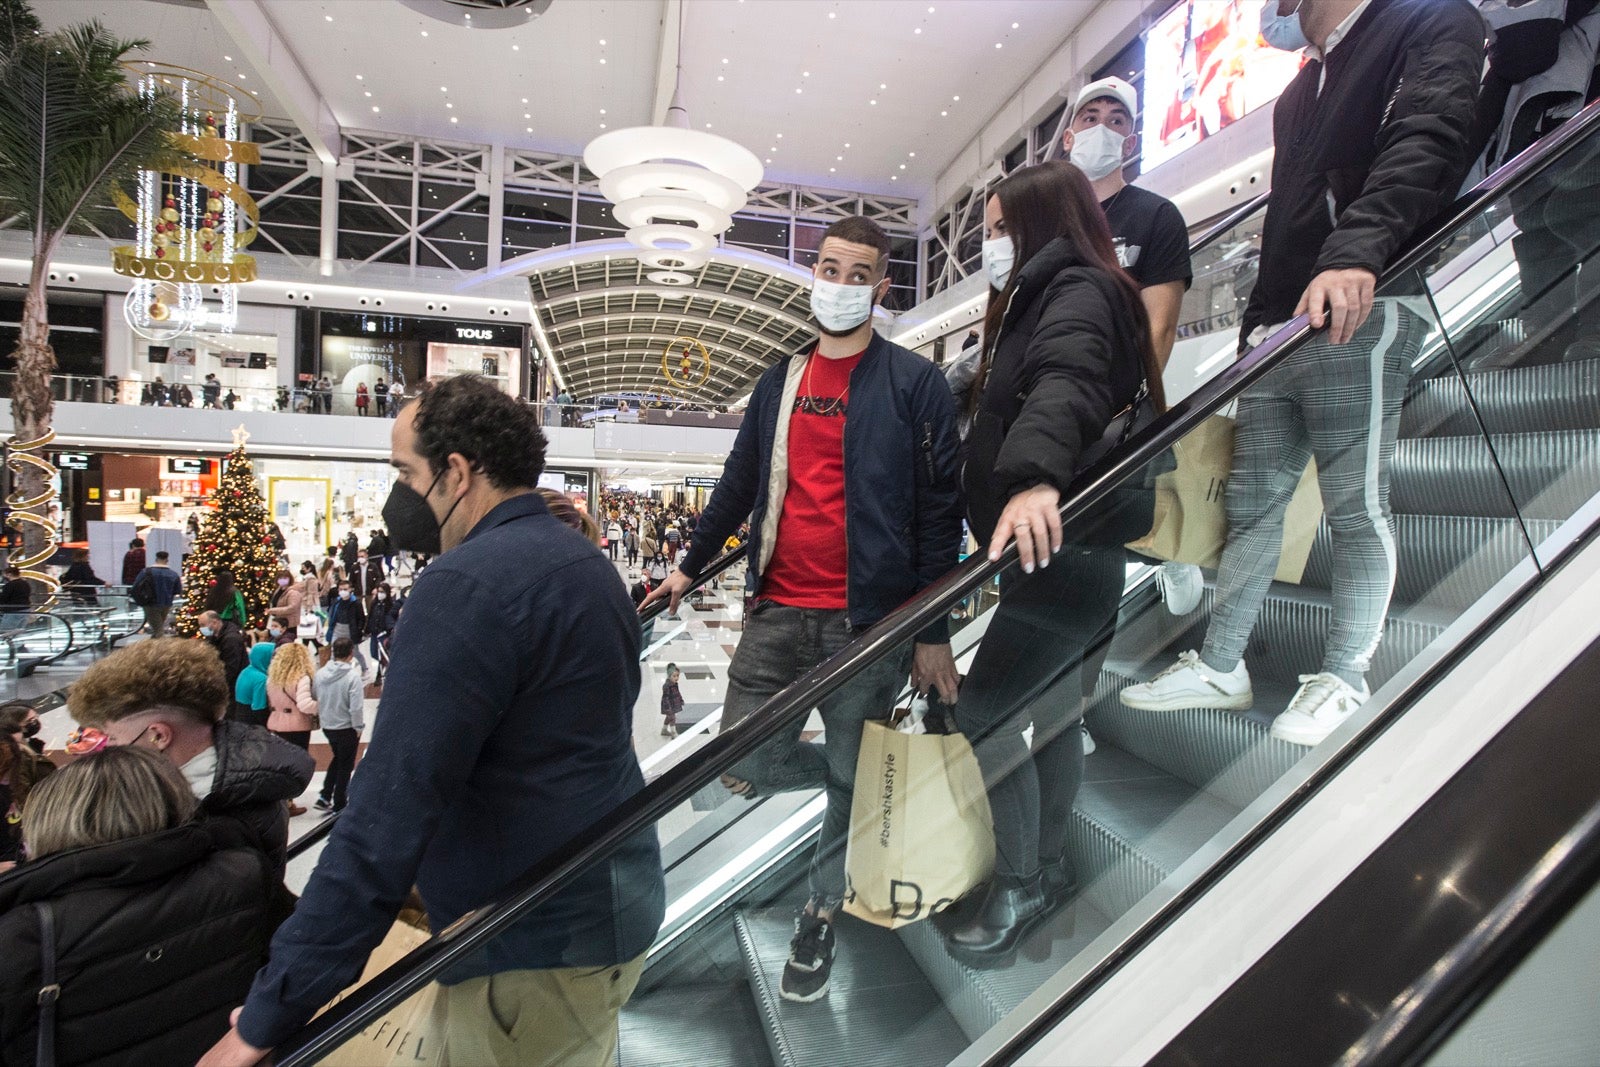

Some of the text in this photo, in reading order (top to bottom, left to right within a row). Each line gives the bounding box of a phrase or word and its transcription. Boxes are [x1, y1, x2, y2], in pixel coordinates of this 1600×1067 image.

[456, 327, 493, 340] TOUS
[350, 352, 393, 361] UNIVERSE
[880, 752, 897, 848] #bershkastyle
